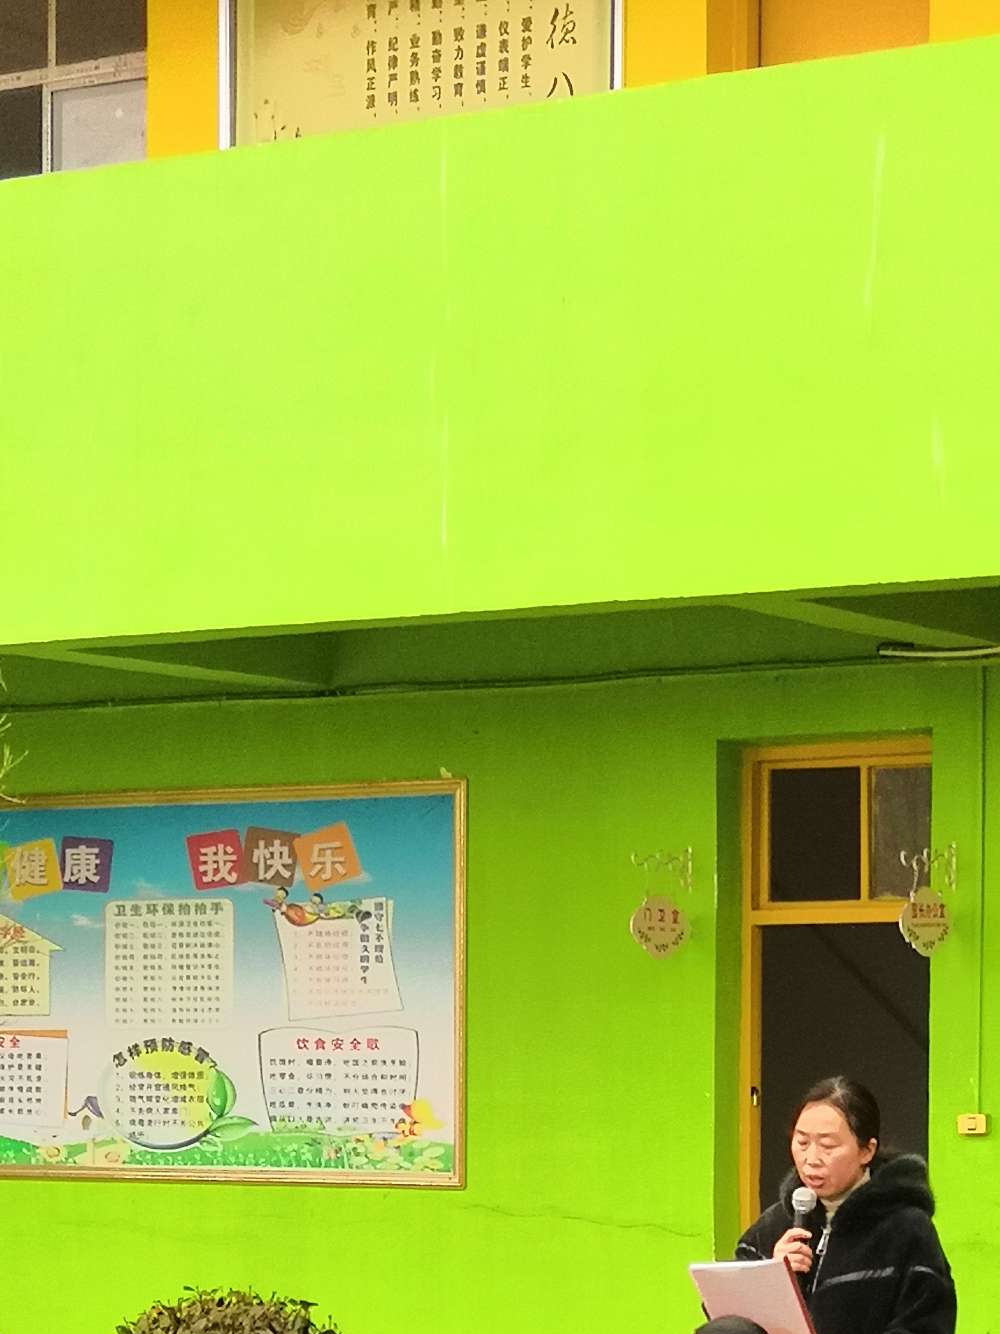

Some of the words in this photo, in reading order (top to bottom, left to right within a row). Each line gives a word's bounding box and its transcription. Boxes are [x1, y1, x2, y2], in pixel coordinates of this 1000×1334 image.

[12, 845, 101, 887] 健康
[199, 839, 347, 883] 我快乐
[296, 1037, 380, 1051] 饮食安全歌
